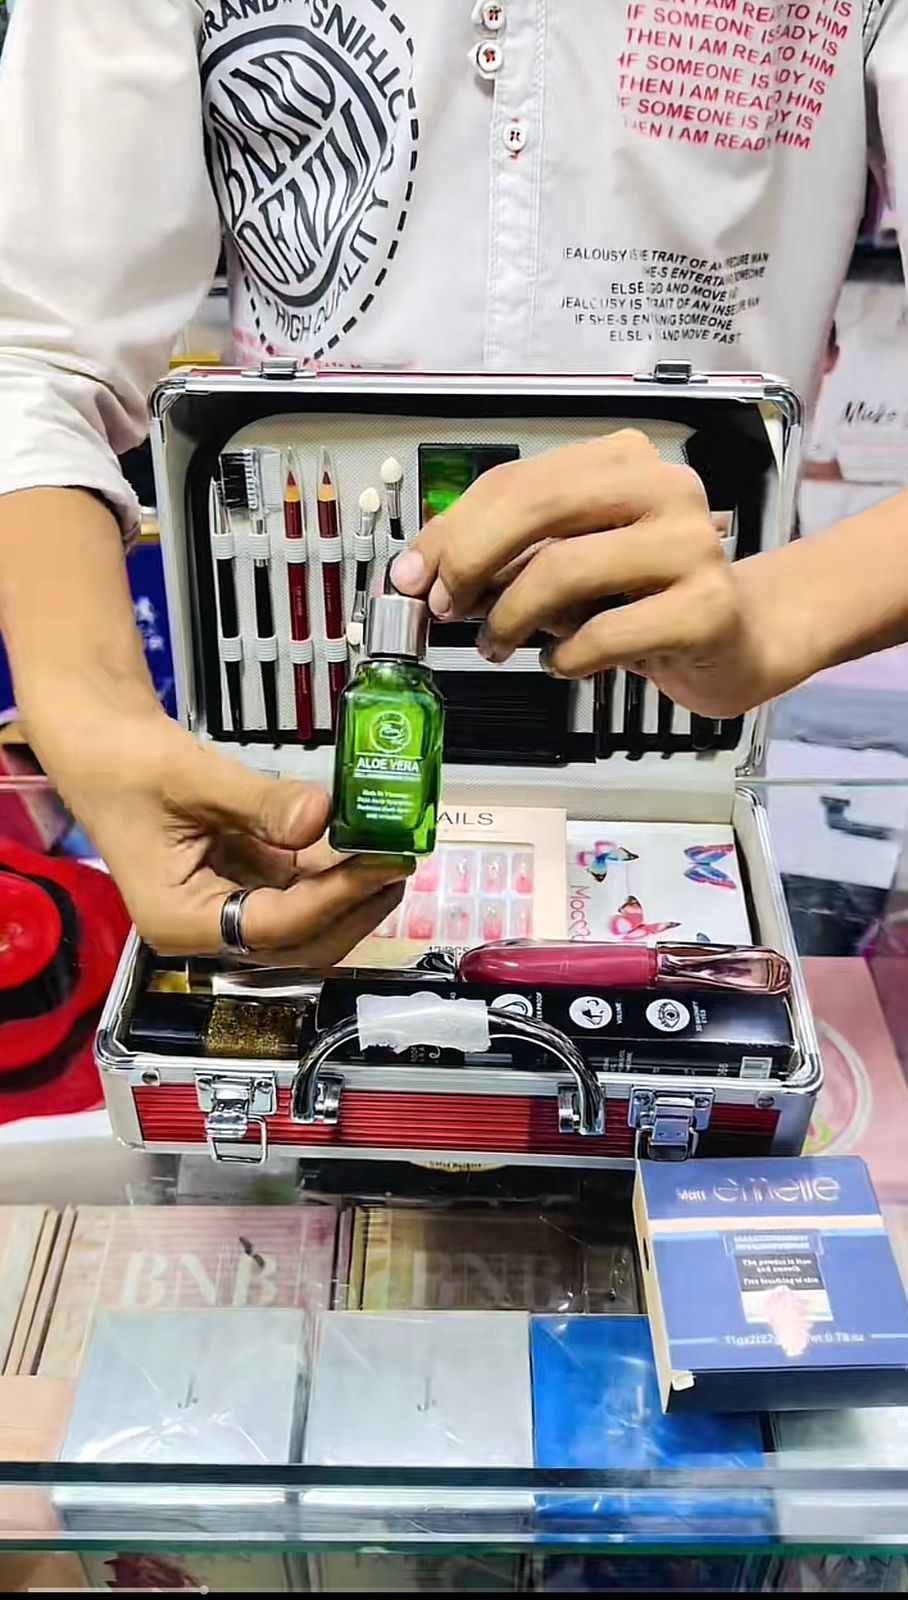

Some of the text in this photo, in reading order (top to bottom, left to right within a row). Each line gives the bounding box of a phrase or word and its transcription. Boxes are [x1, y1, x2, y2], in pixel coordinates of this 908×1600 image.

[627, 4, 646, 20] IF
[653, 7, 755, 39] SOMEONE
[822, 38, 838, 57] IS
[787, 3, 810, 20] TO
[815, 11, 848, 39] HIM
[626, 27, 682, 49] THEN
[688, 35, 694, 51] I
[697, 38, 728, 57] AM
[800, 50, 835, 77] HIM
[646, 54, 744, 84] SOMEONE
[751, 73, 769, 90] IS
[808, 78, 826, 96] IS
[618, 75, 674, 96] THEN
[679, 82, 685, 97] I
[688, 84, 720, 102] AM
[786, 91, 823, 116] HIM
[637, 98, 736, 127] SOMEONE
[741, 115, 760, 130] IS
[796, 113, 813, 130] IS
[668, 126, 674, 139] I
[679, 127, 710, 144] AM
[775, 129, 812, 149] HIM
[651, 250, 688, 265] TRAIT
[689, 258, 708, 270] OF
[611, 281, 645, 295] ELSE
[666, 282, 690, 295] AND
[691, 285, 728, 303] MOVE
[630, 299, 643, 311] IS
[692, 300, 711, 313] AN
[575, 313, 585, 326] IF
[678, 314, 733, 331] SOMEONE
[712, 332, 743, 345] FAST
[357, 757, 419, 773] ALOE VERA
[436, 811, 495, 827] AILS
[120, 1251, 278, 1307] BNB
